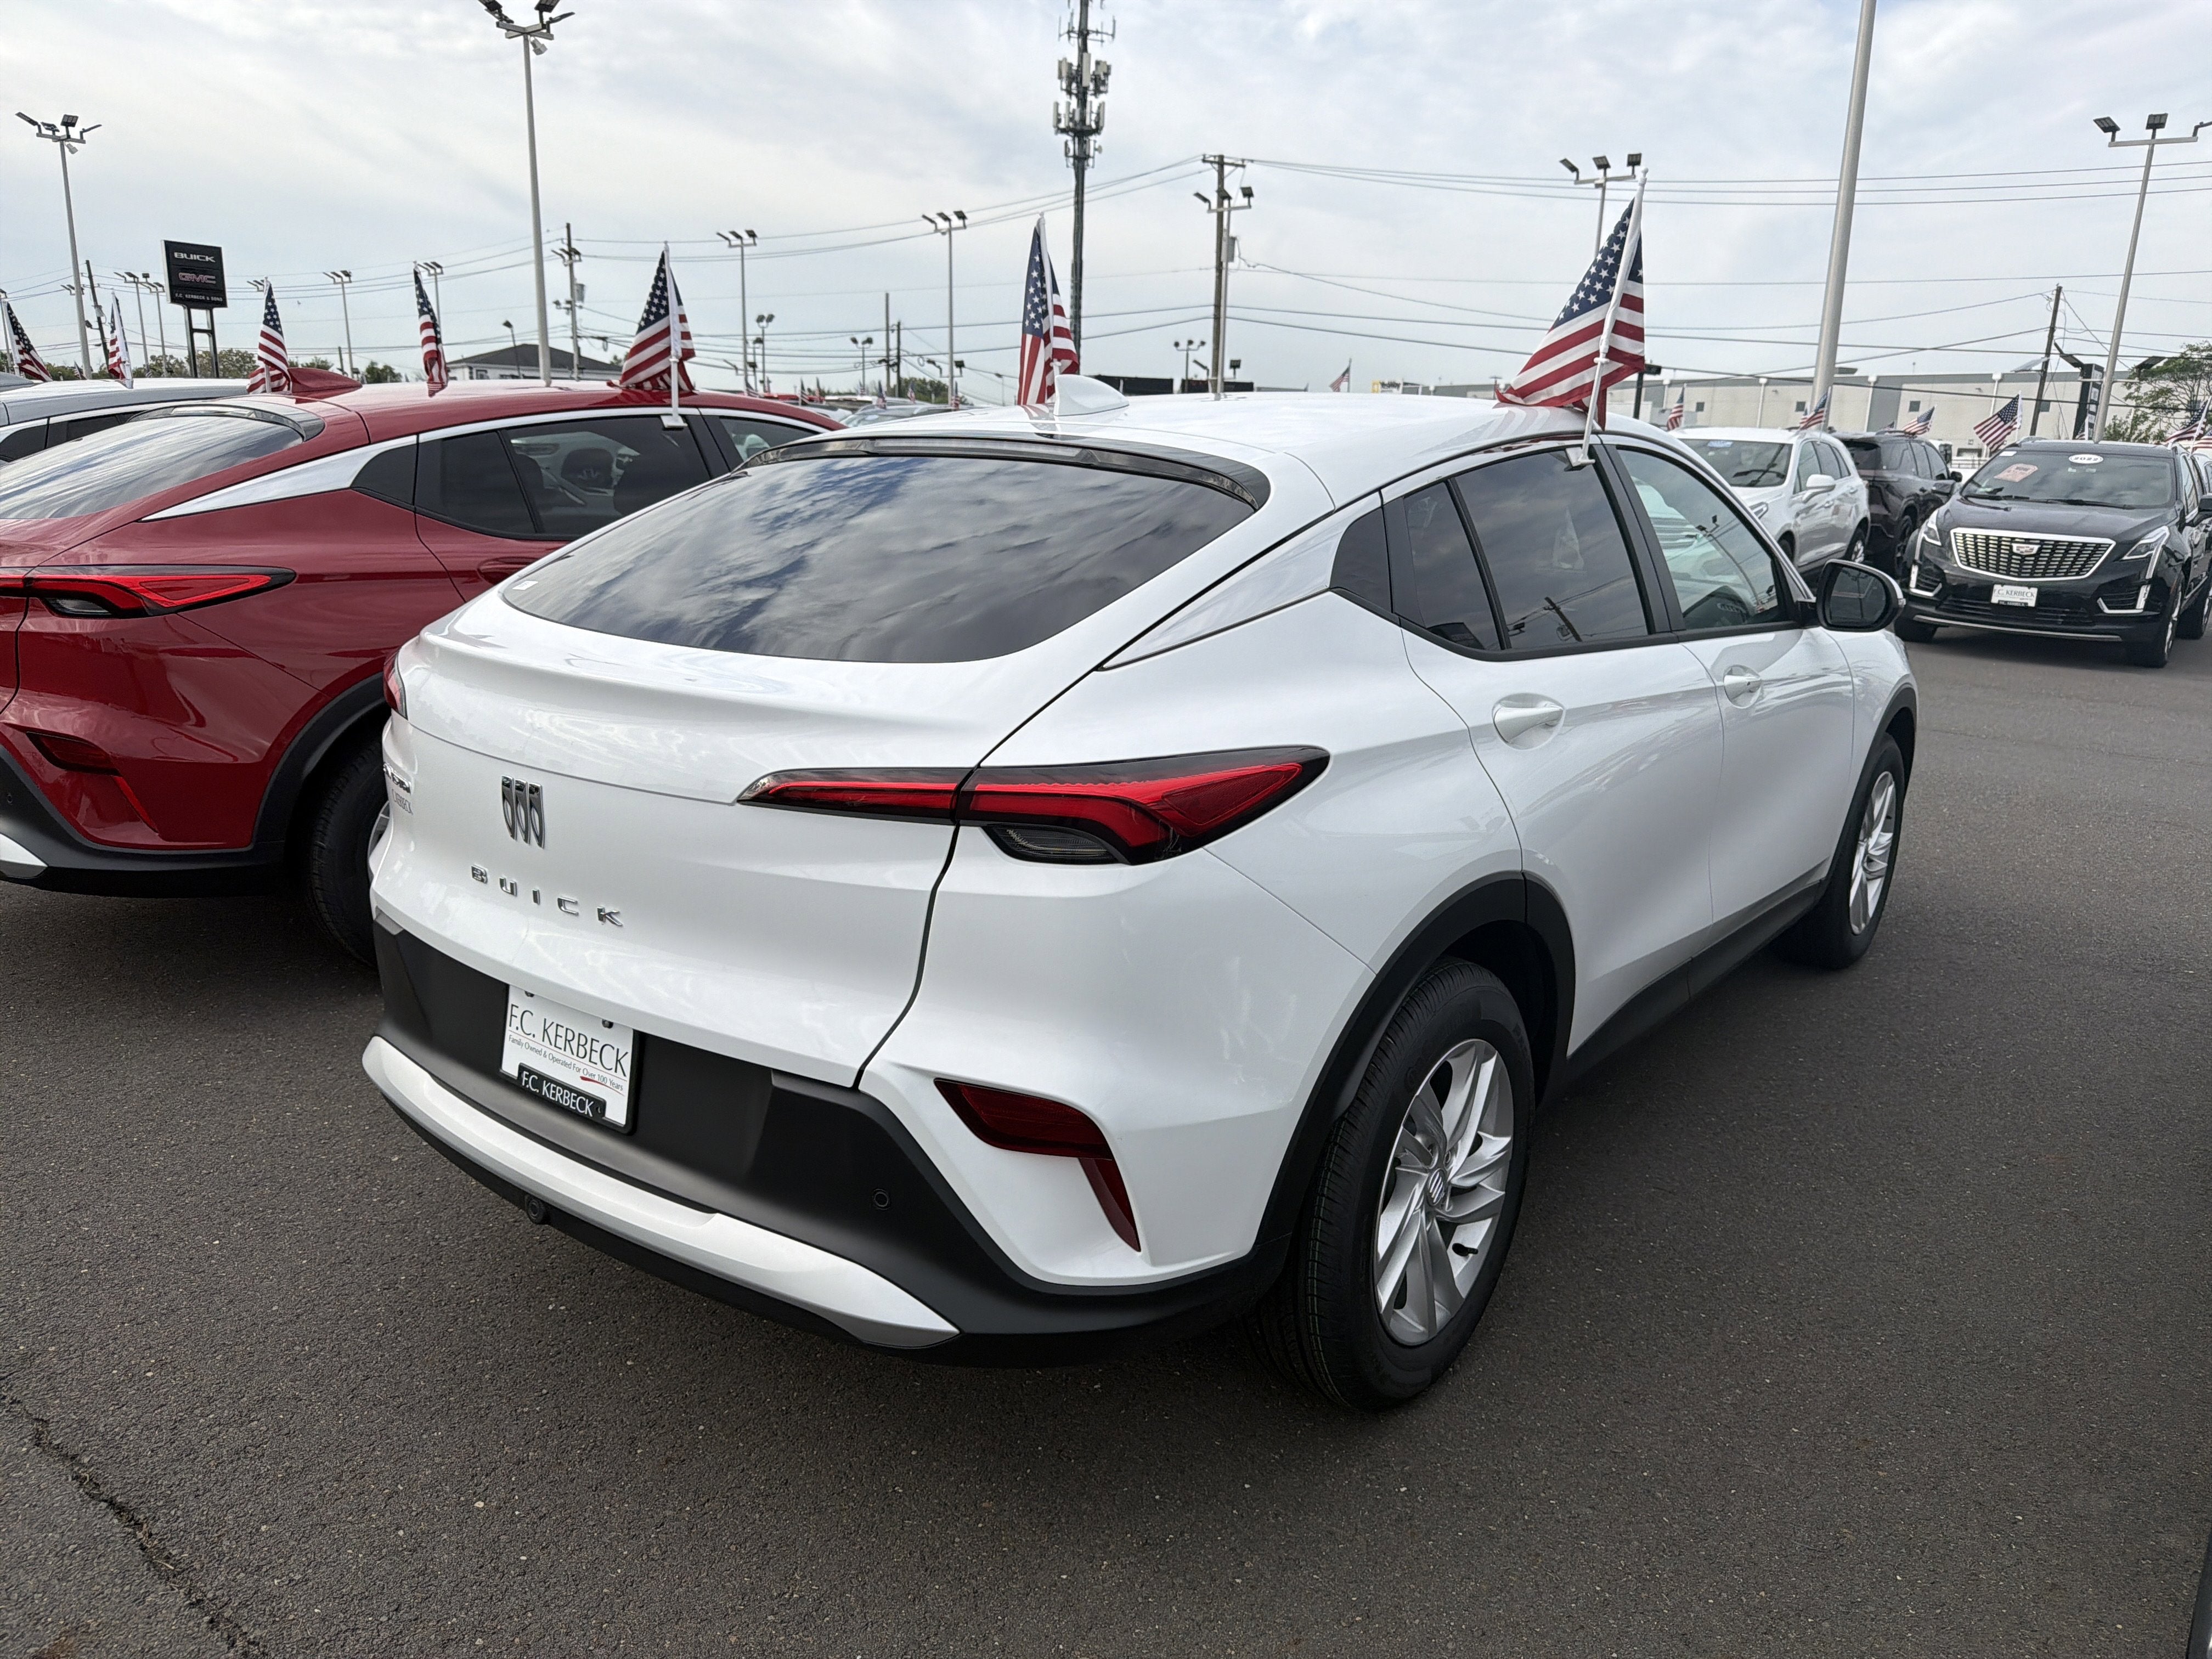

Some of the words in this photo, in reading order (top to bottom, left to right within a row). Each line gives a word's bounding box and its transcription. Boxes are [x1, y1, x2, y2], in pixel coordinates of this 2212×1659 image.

[174, 252, 215, 262] BUICK
[179, 272, 216, 284] GMC
[2006, 589, 2035, 597] KERBECK
[471, 864, 623, 927] BUICK
[509, 1003, 535, 1038] F.C.
[542, 1018, 629, 1077] KERBECK
[509, 1035, 524, 1049] Family
[524, 1042, 543, 1056] Owned
[548, 1053, 572, 1070] Operated
[573, 1062, 582, 1073] For
[583, 1068, 596, 1079] Over
[597, 1074, 608, 1085] 100
[608, 1078, 623, 1091] Years
[521, 1071, 539, 1093] F.C.
[542, 1082, 594, 1118] KERBECK
